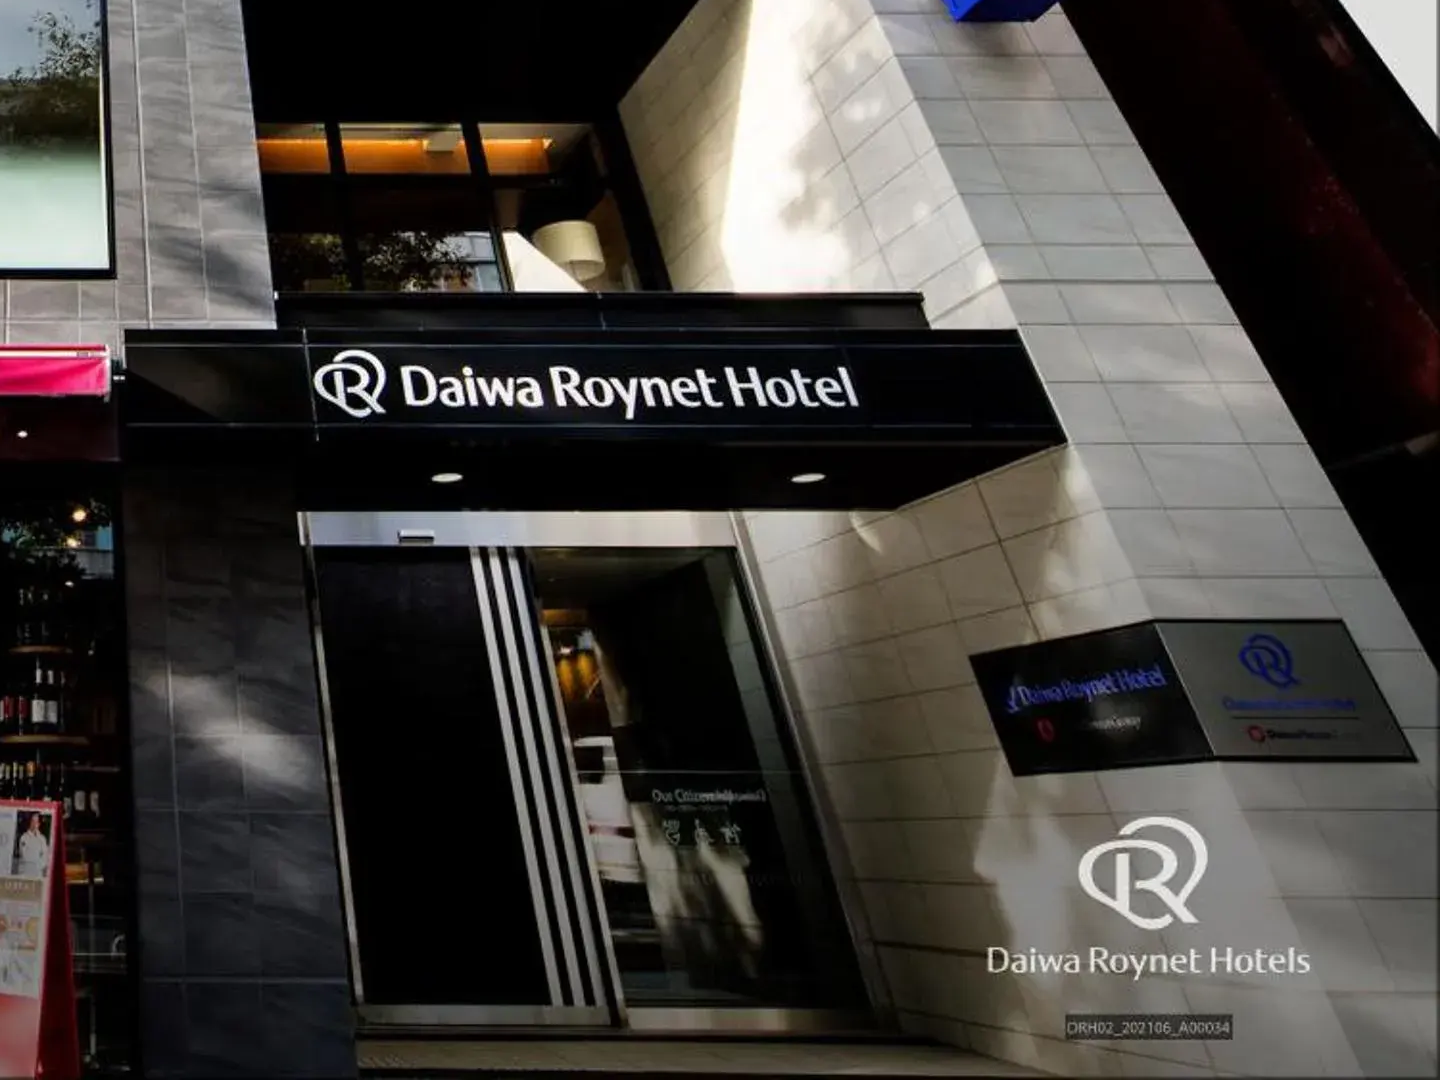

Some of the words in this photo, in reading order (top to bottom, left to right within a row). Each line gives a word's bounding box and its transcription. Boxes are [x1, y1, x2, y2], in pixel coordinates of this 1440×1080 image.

[399, 365, 544, 408] Daiwa
[548, 366, 722, 420] Roynet
[724, 366, 860, 408] Hotel
